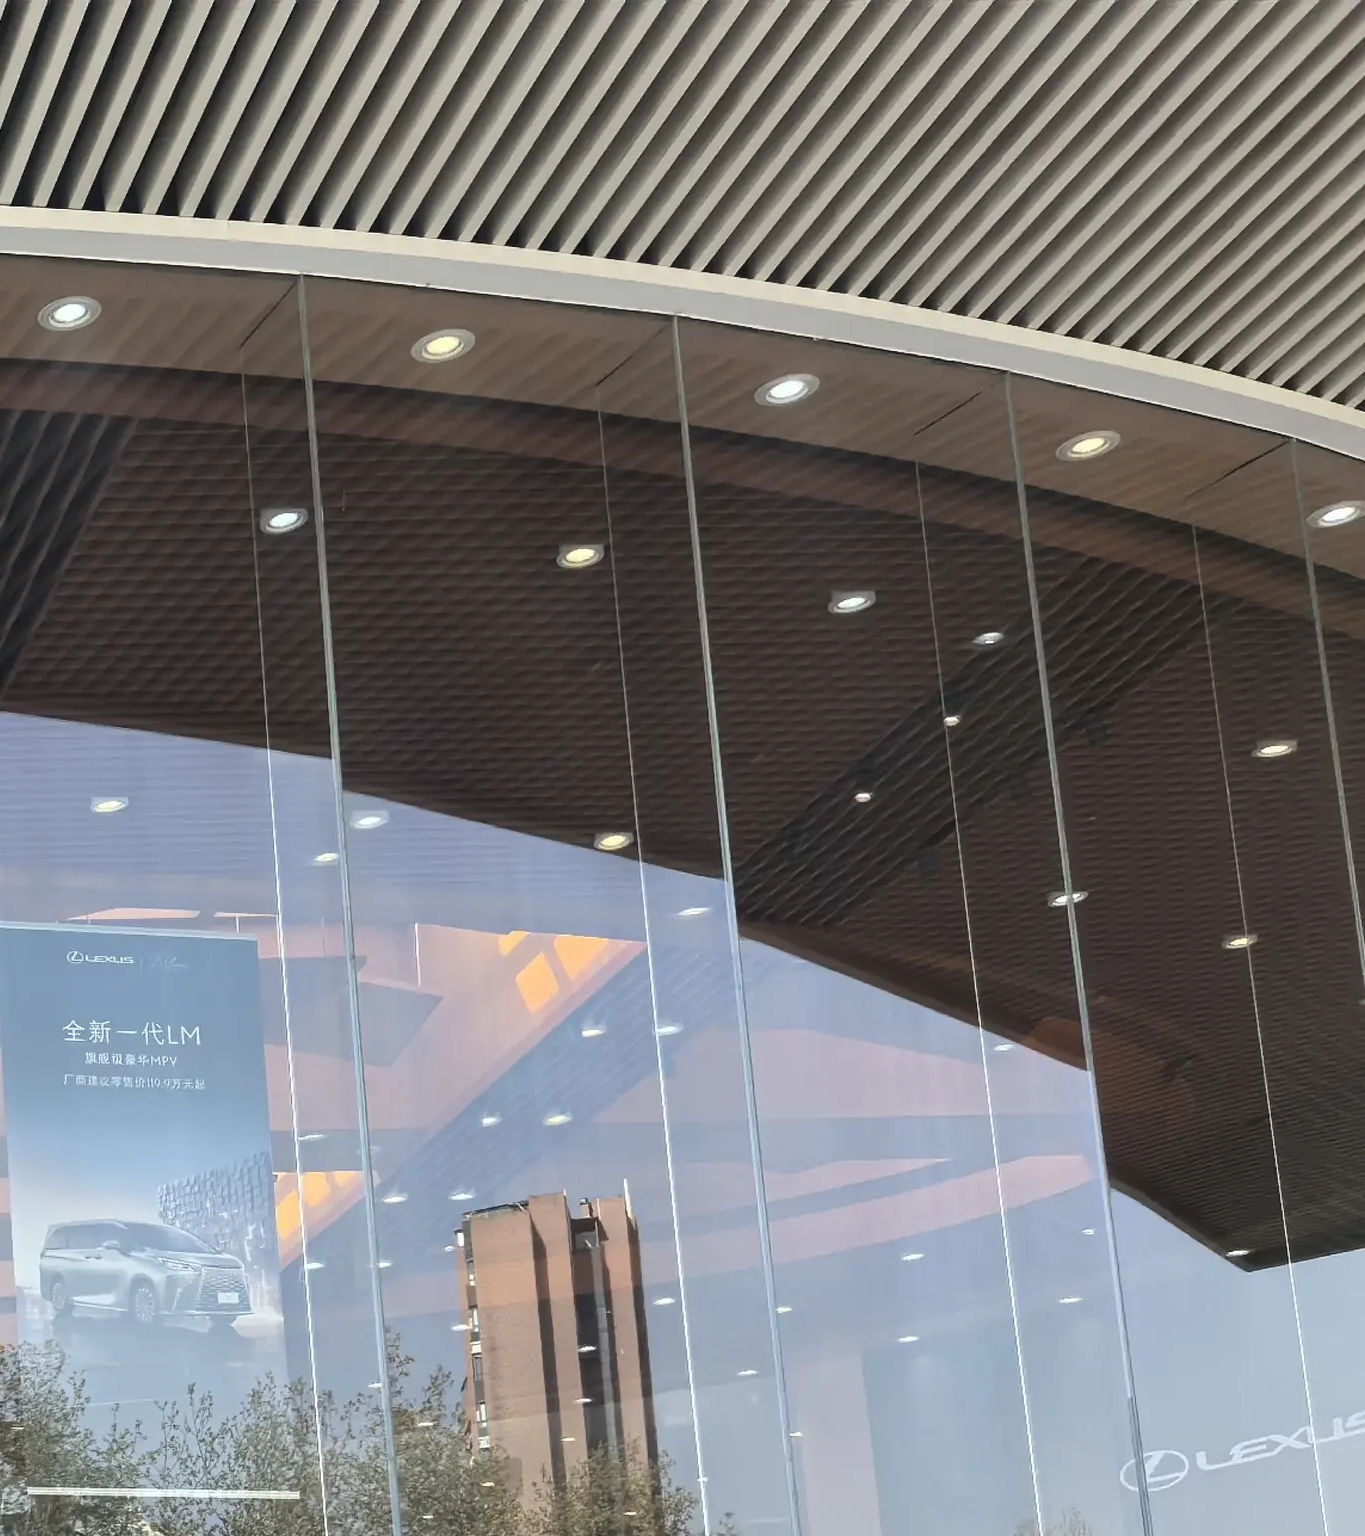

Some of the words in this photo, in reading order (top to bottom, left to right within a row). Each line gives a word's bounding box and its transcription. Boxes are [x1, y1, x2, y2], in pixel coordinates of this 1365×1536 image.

[85, 955, 135, 964] LEXUS
[62, 1019, 201, 1046] 全新一代LM
[85, 1051, 177, 1067] 旗舰级豪华MPV
